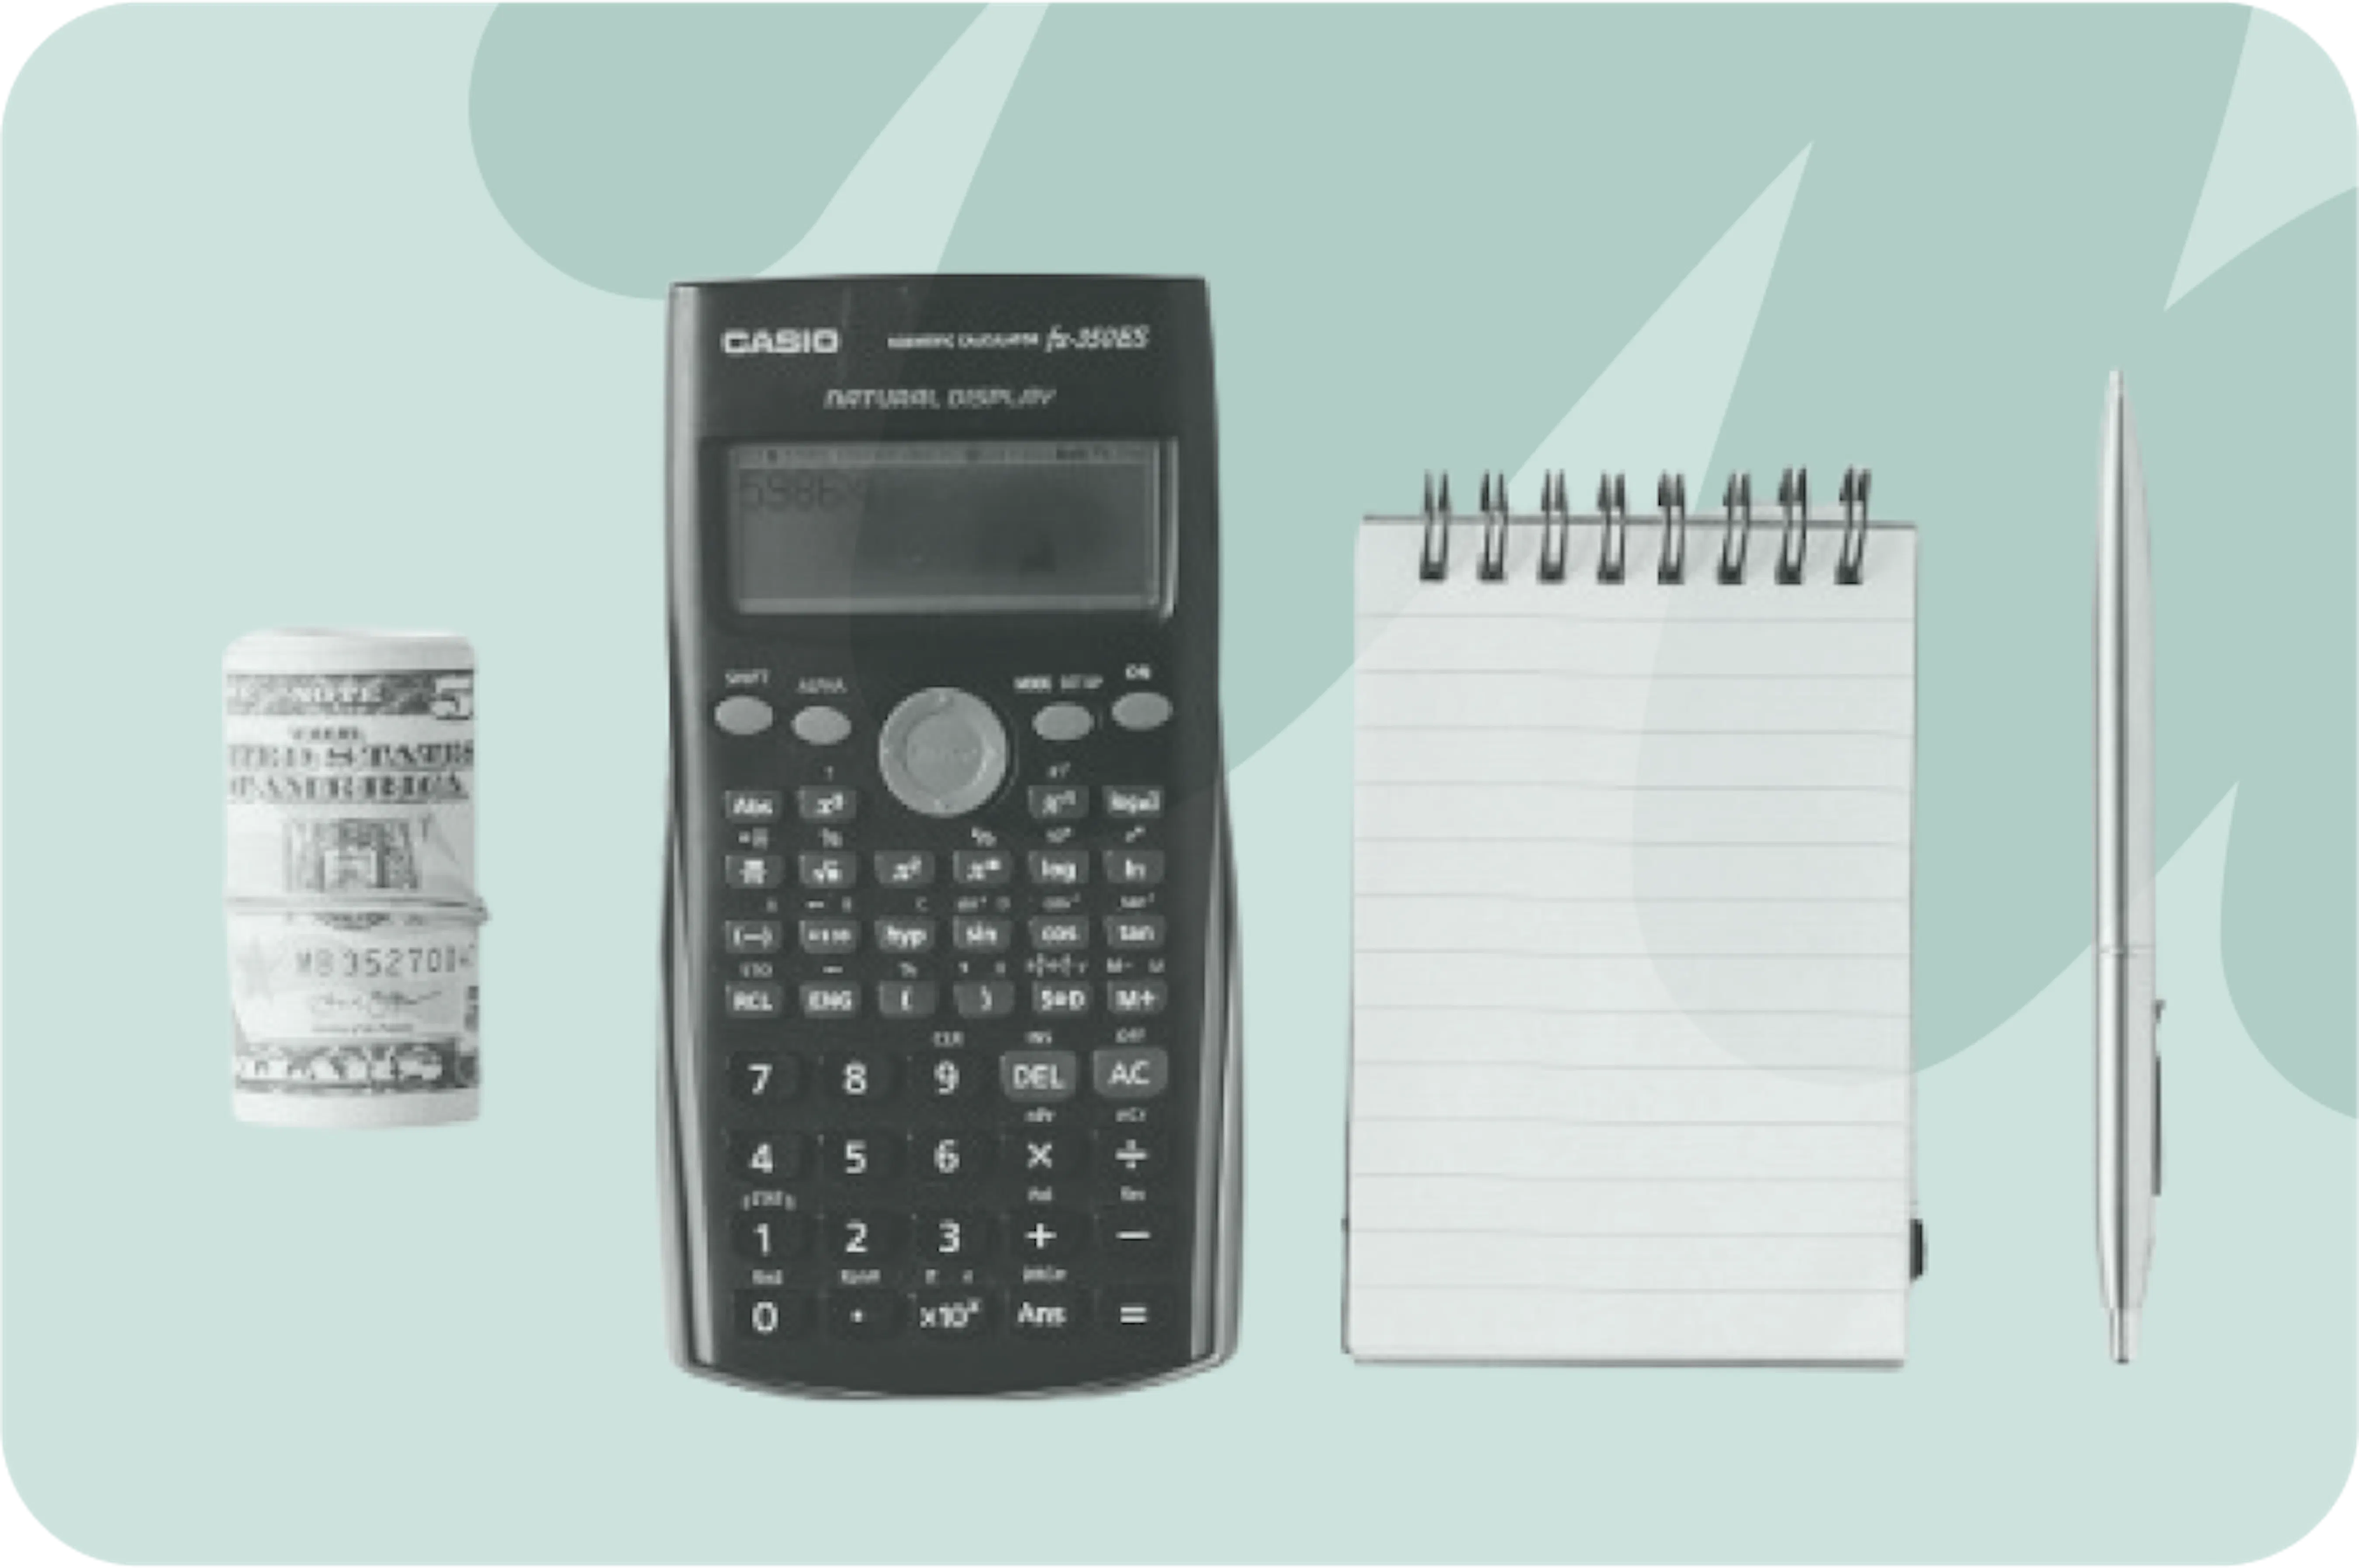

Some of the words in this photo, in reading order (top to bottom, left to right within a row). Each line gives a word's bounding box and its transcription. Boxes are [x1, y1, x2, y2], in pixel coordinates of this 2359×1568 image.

[721, 328, 839, 354] CASIO
[825, 388, 939, 409] NATURAL
[947, 388, 1057, 408] DISPLAY
[1125, 665, 1151, 680] ON
[432, 673, 474, 721] 5
[1041, 860, 1076, 882] log
[886, 926, 927, 947] hyp
[966, 925, 997, 943] sin
[1041, 926, 1077, 941] cos
[1119, 925, 1154, 941] tan
[733, 991, 773, 1011] RCL
[808, 990, 852, 1011] ENG
[1117, 990, 1155, 1010] M+
[749, 1064, 772, 1094] 7
[844, 1063, 867, 1095] 8
[934, 1060, 959, 1095] 9
[1013, 1064, 1063, 1089] DEL
[1110, 1060, 1150, 1085] AC
[751, 1143, 773, 1173] 4
[845, 1142, 867, 1174] 5
[934, 1139, 960, 1173] 6
[756, 1223, 769, 1254] 1
[846, 1223, 867, 1253] 2
[939, 1222, 960, 1253] 3
[752, 1302, 778, 1333] 0
[1017, 1302, 1066, 1324] Ans
